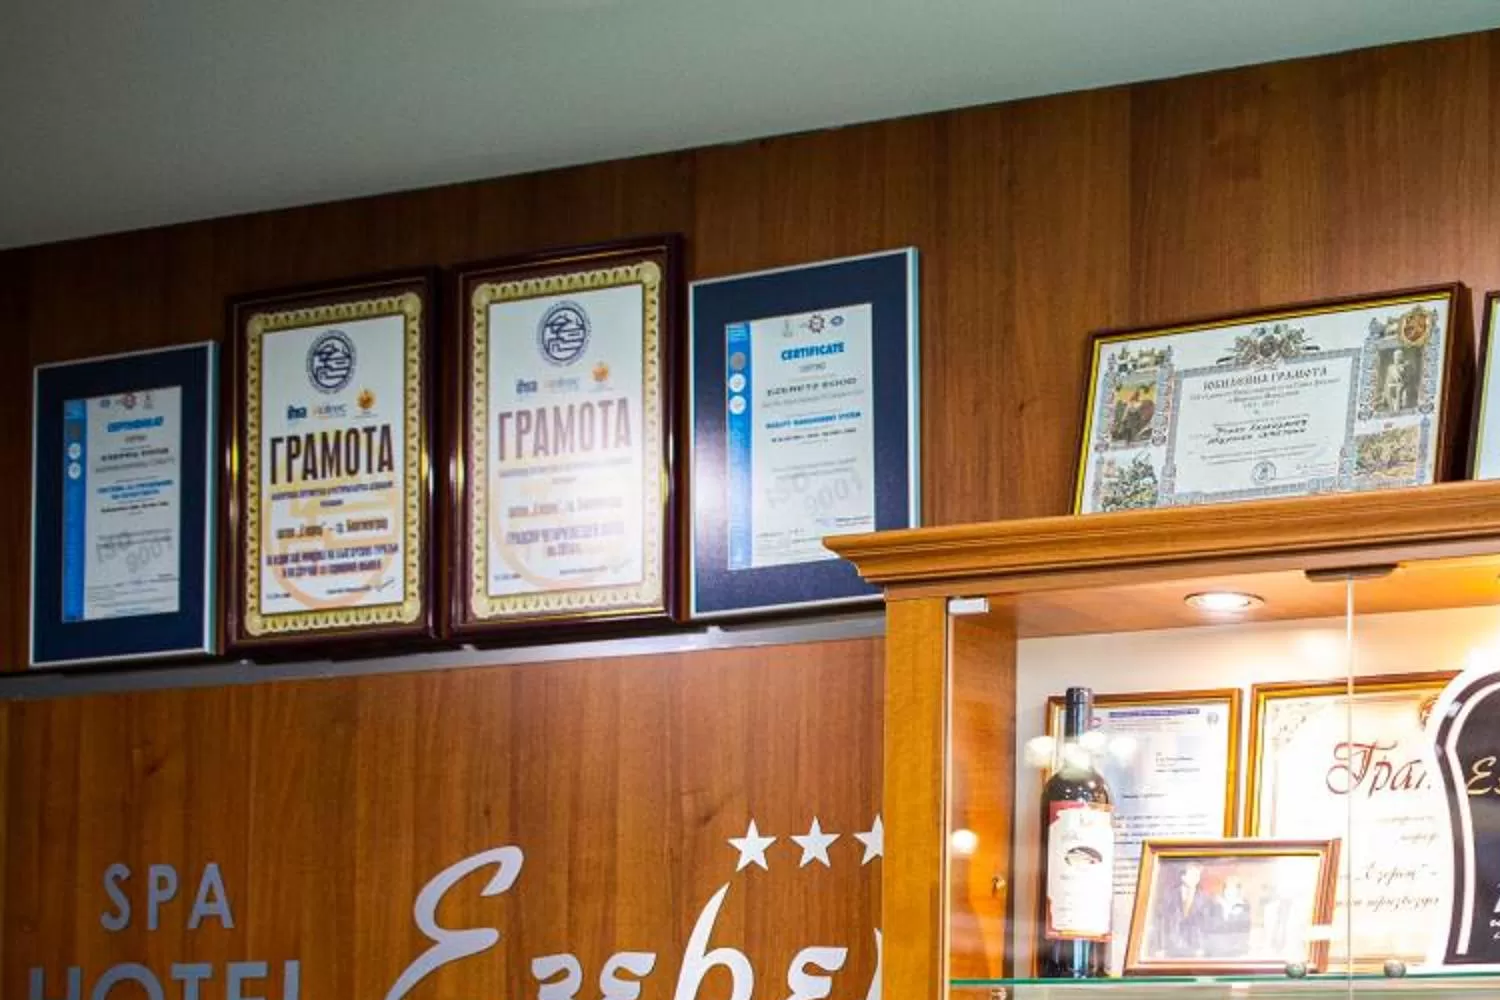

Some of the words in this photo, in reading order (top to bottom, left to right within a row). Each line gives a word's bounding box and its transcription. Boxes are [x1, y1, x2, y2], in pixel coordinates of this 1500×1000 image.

[781, 341, 845, 361] CERTIFICATE
[270, 424, 394, 485] ГРАМОТА
[498, 397, 632, 461] ГРАМОТА
[100, 862, 234, 931] SPA
